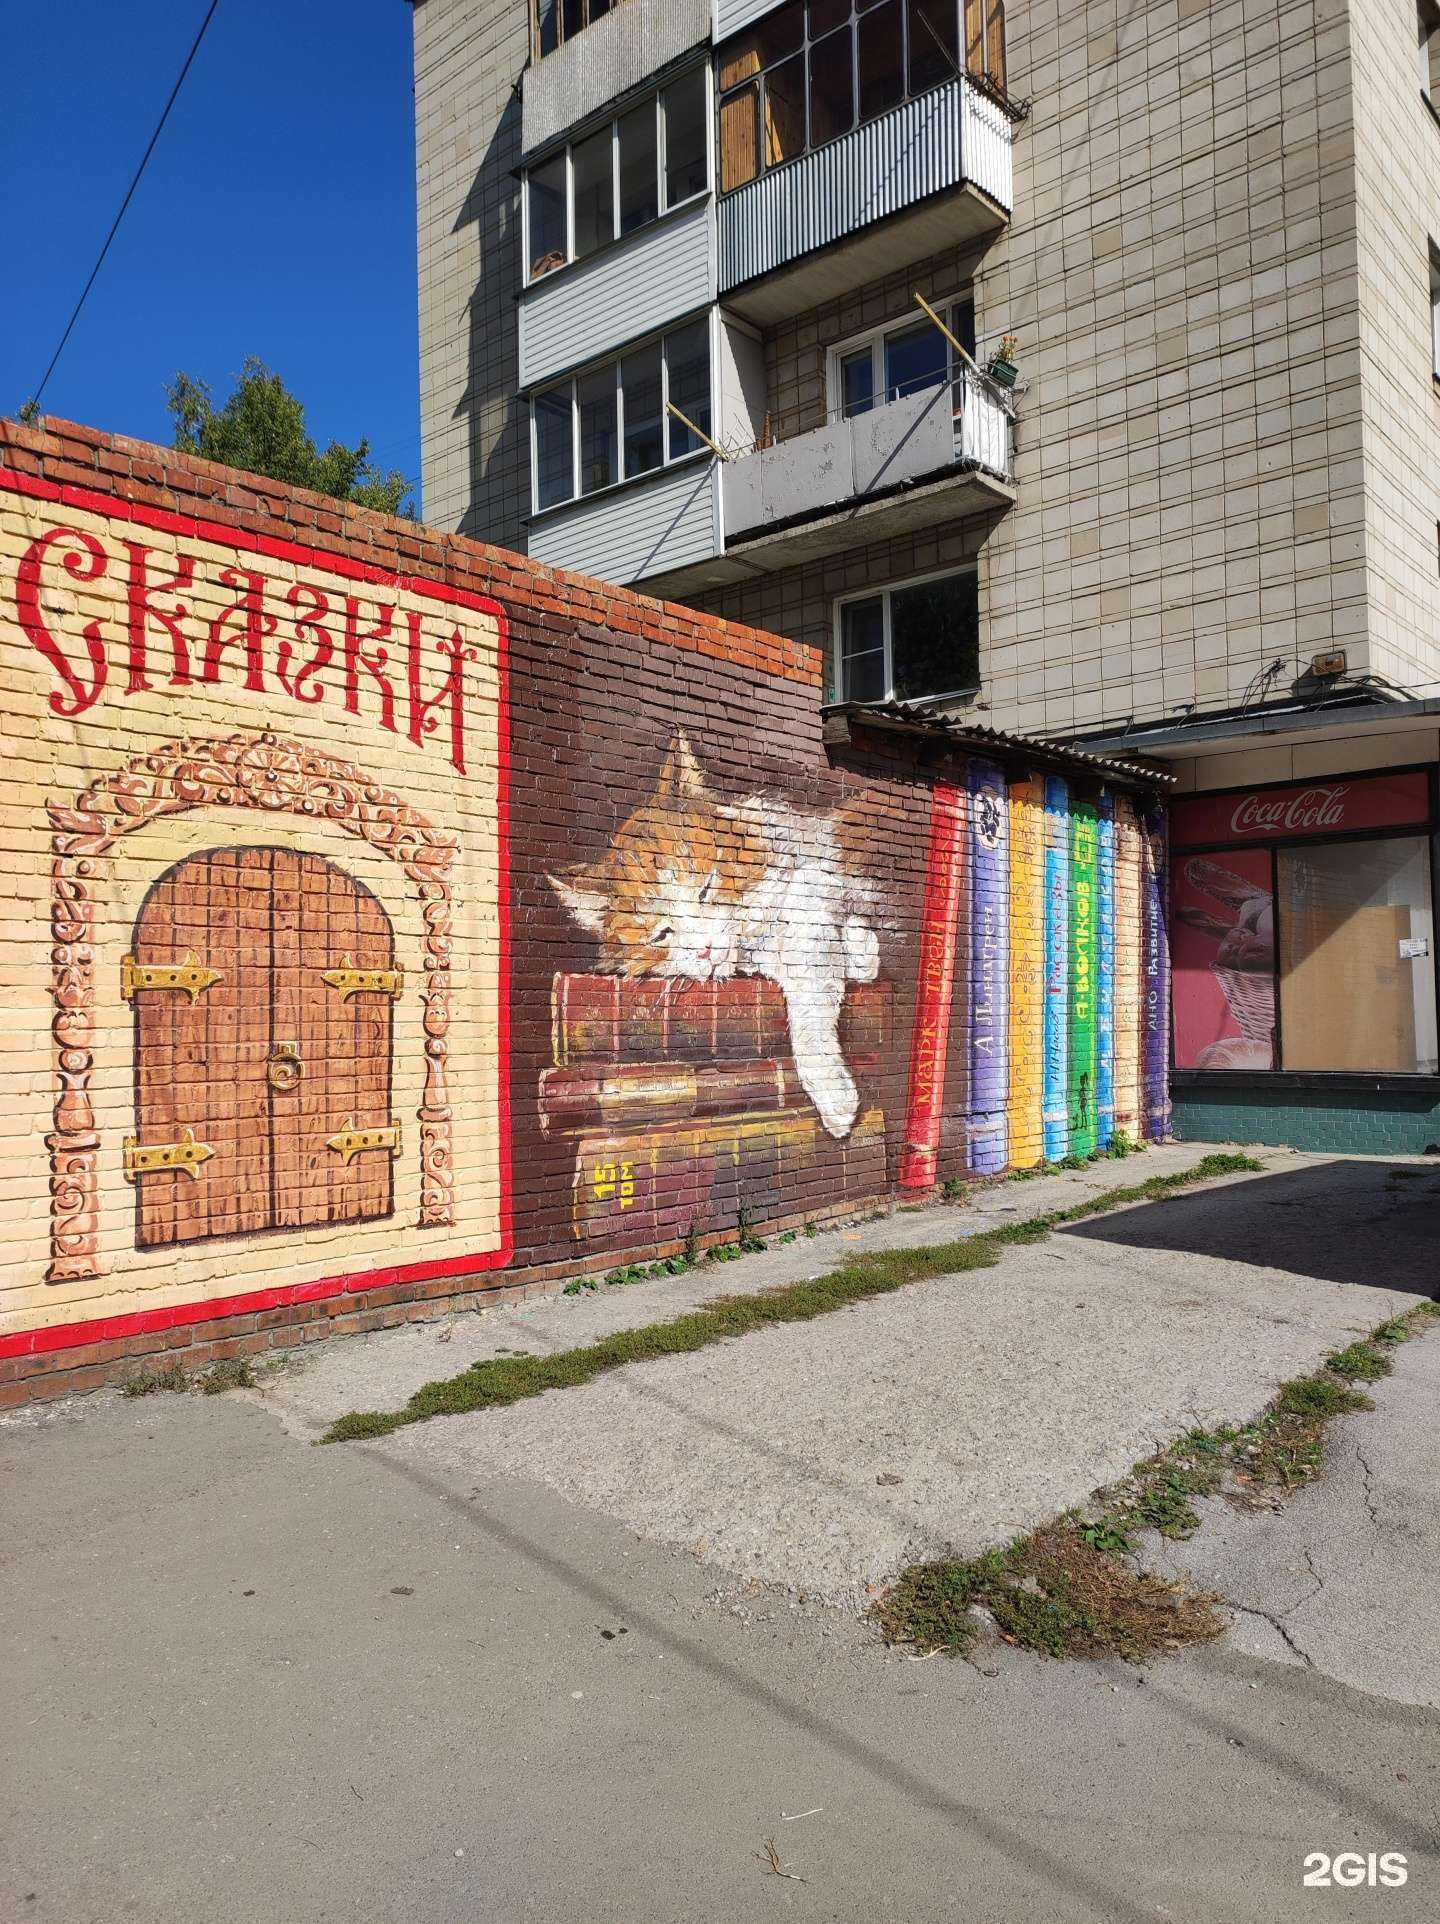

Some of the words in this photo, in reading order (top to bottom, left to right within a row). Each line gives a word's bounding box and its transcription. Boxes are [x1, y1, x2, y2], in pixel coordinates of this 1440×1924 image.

[15, 527, 477, 776] СКАЗКИ
[1230, 783, 1351, 833] Coca-Cola
[1148, 990, 1158, 1032] АНО
